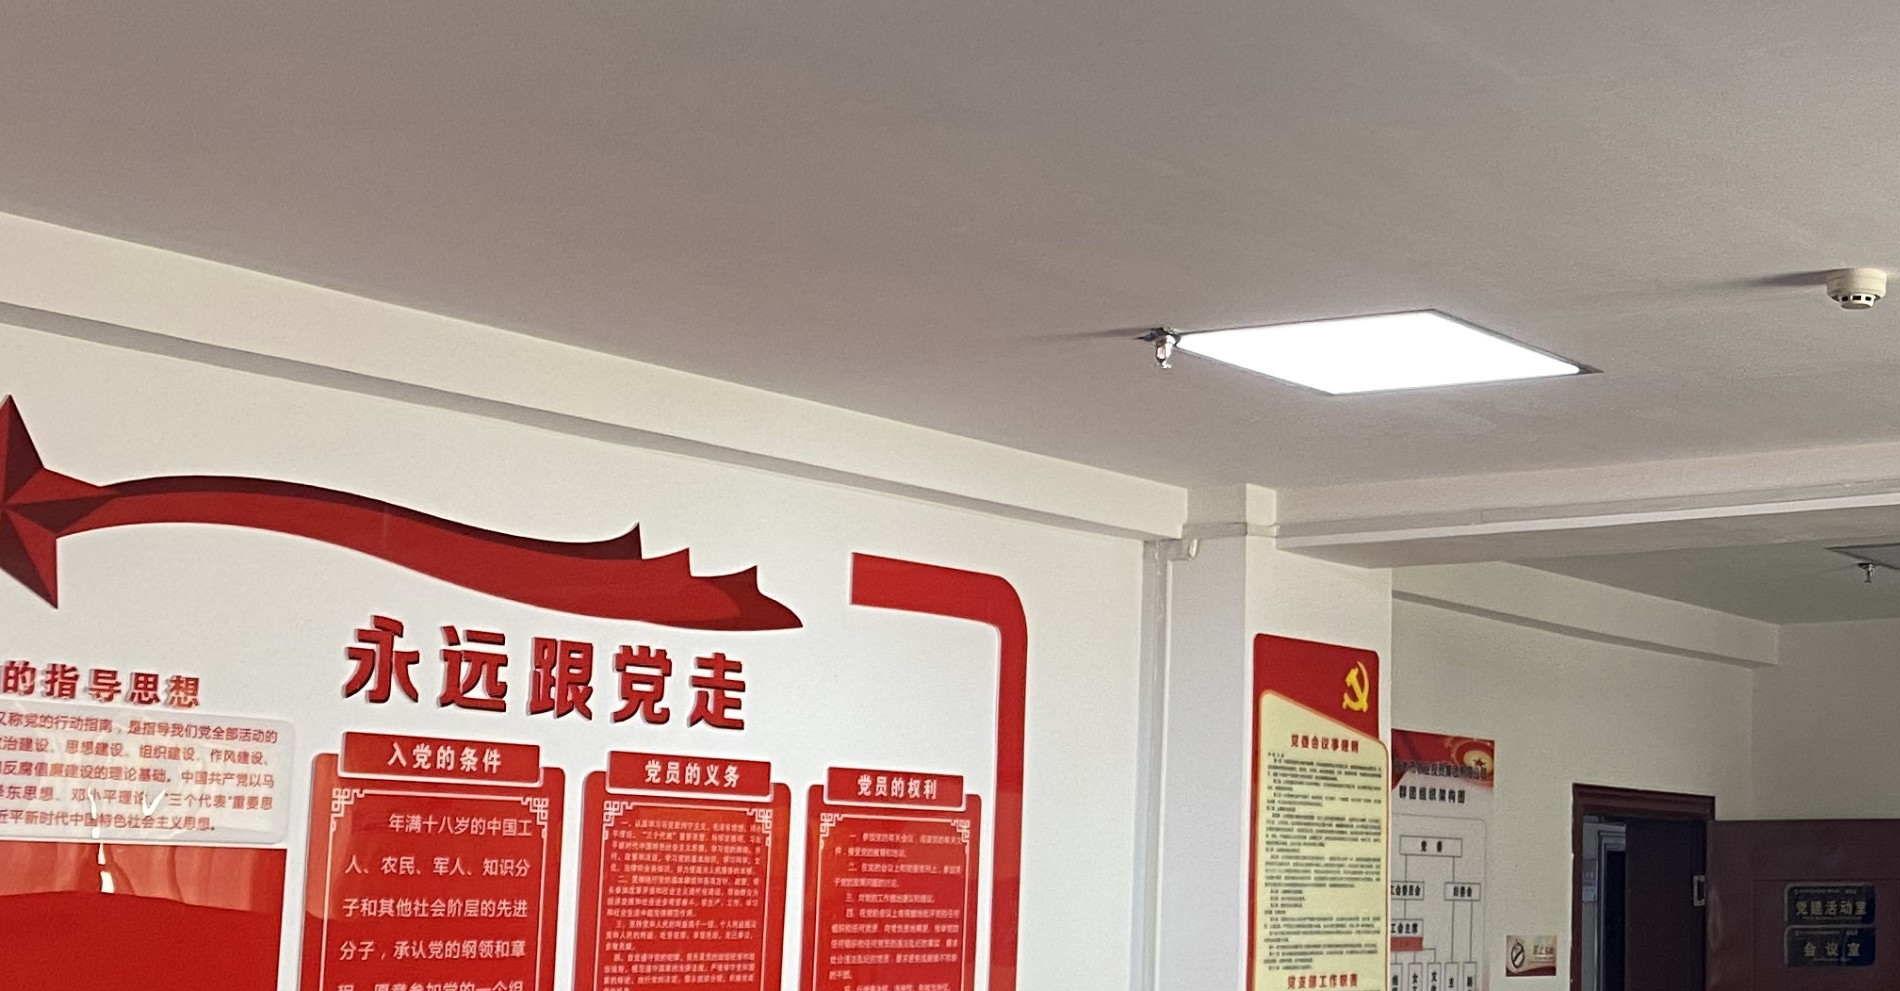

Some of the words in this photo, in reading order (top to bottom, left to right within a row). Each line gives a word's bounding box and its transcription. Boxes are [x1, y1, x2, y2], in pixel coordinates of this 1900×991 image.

[342, 615, 745, 730] 永远跟党走
[2, 660, 200, 708] 的指导思想
[387, 742, 502, 774] 入党的条件
[645, 759, 740, 788] 党员的义务
[858, 774, 936, 799] 党员的权利
[389, 814, 532, 837] 年满十八岁的中国工
[345, 855, 531, 877] 人、农民、军人、知识分
[343, 898, 528, 918] 子和其他社会阶层的先进
[1796, 900, 1867, 915] 党建活动室
[340, 940, 526, 961] 分子，承认党的纲领和章
[1803, 942, 1860, 957] 会议室
[1287, 973, 1358, 990] 党支部工作职责
